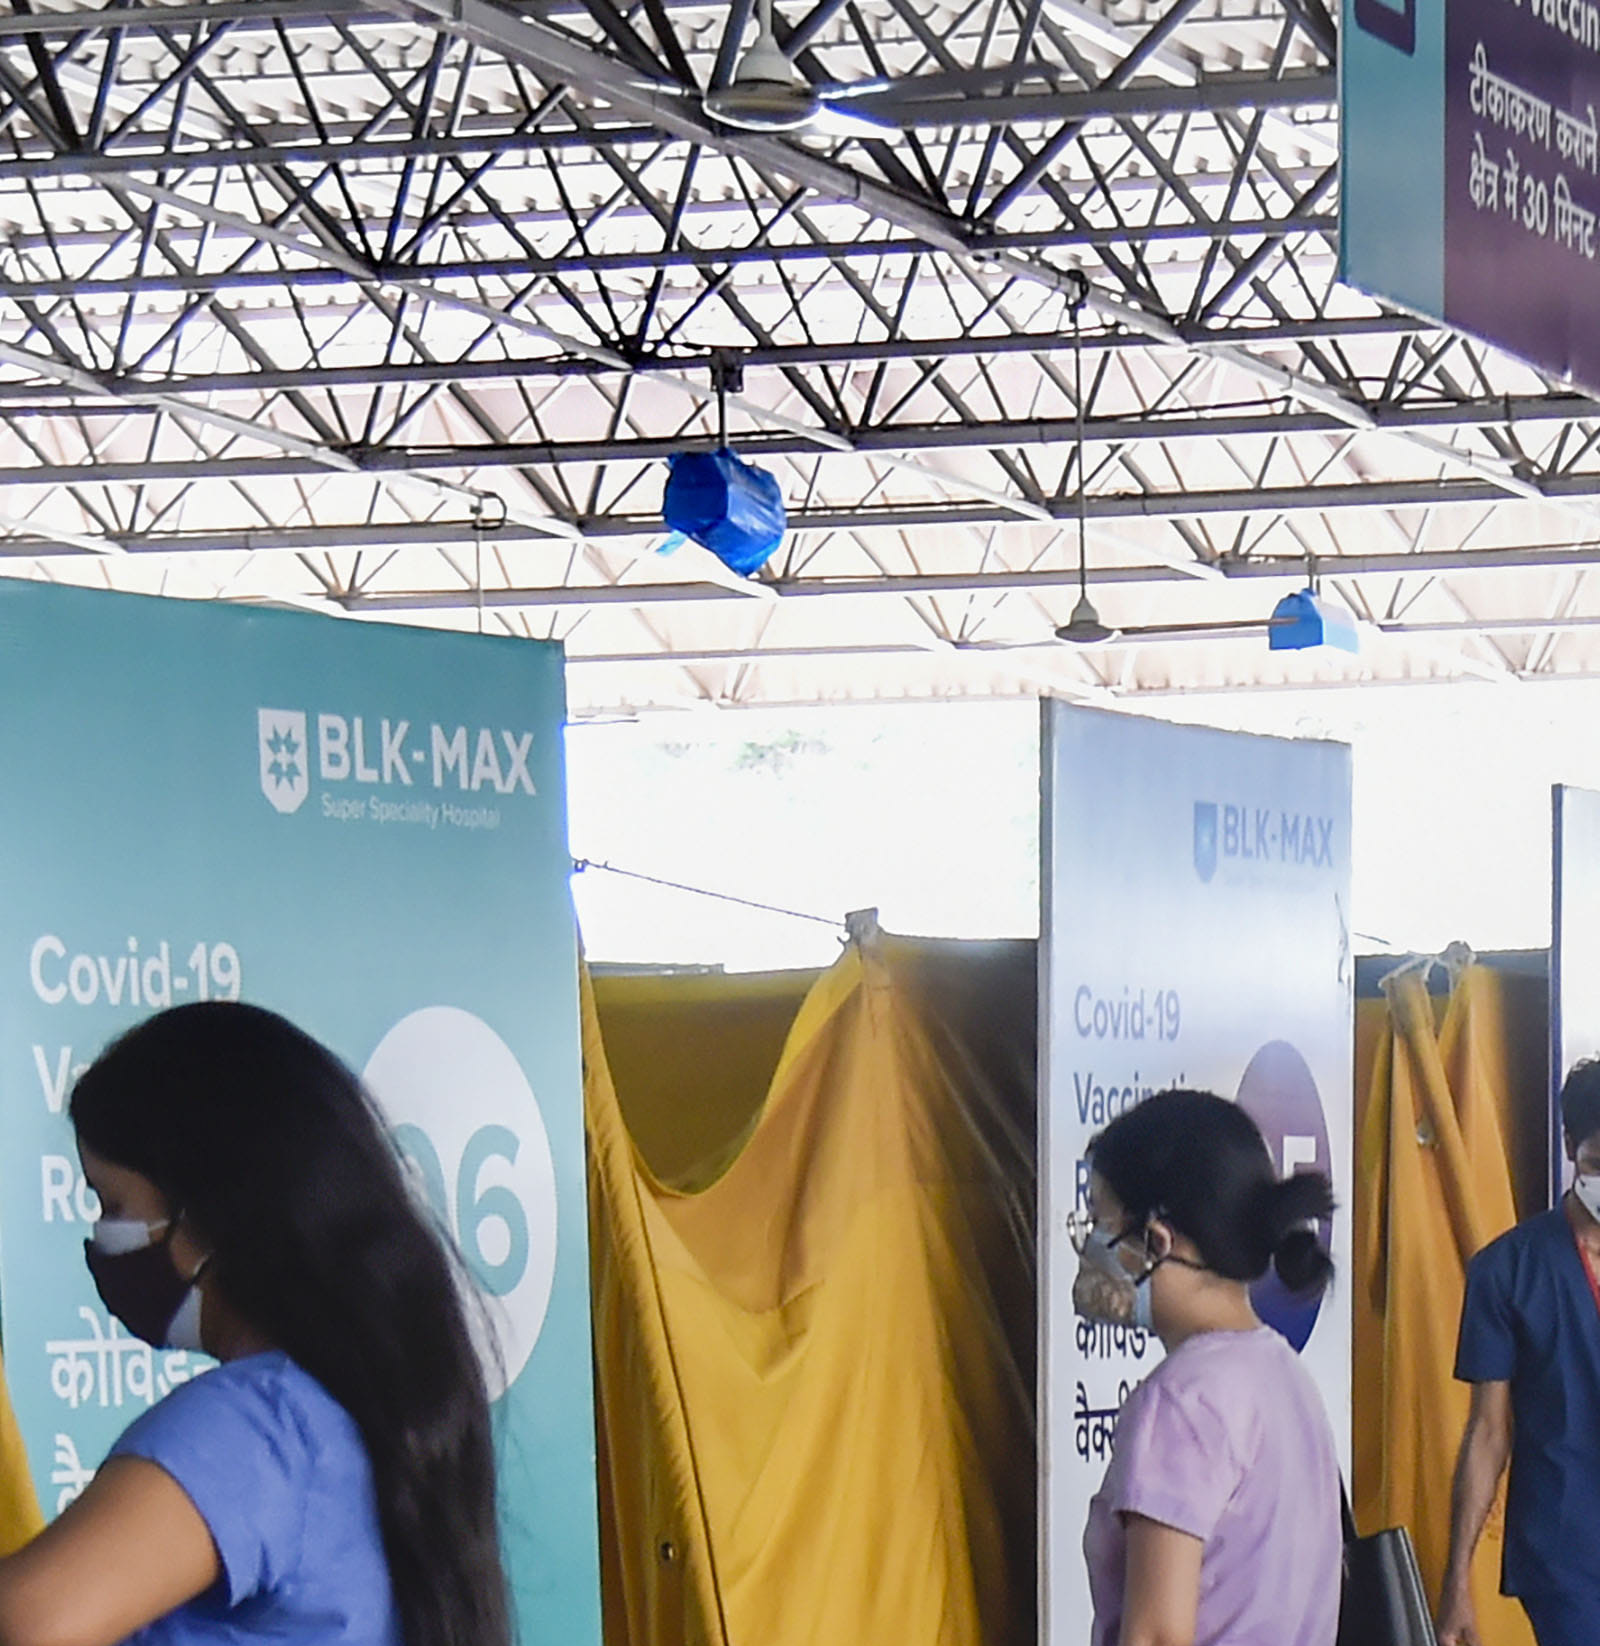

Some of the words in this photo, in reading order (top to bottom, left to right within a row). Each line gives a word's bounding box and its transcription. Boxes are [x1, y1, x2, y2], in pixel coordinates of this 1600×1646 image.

[1469, 40, 1551, 150] टीकाकरण
[1555, 104, 1597, 175] कराने
[1469, 131, 1499, 212] क्षेत्र
[1503, 147, 1520, 221] में
[1522, 174, 1548, 236] 30
[1554, 173, 1596, 259] मिनट
[318, 713, 537, 796] BLK-MAX
[321, 793, 365, 823] Super
[369, 796, 439, 830] Speciality
[441, 803, 500, 831] Hospital
[1223, 803, 1334, 869] BLK-MAX
[30, 935, 241, 1007] Covid-19
[1074, 984, 1181, 1042] Covid-19
